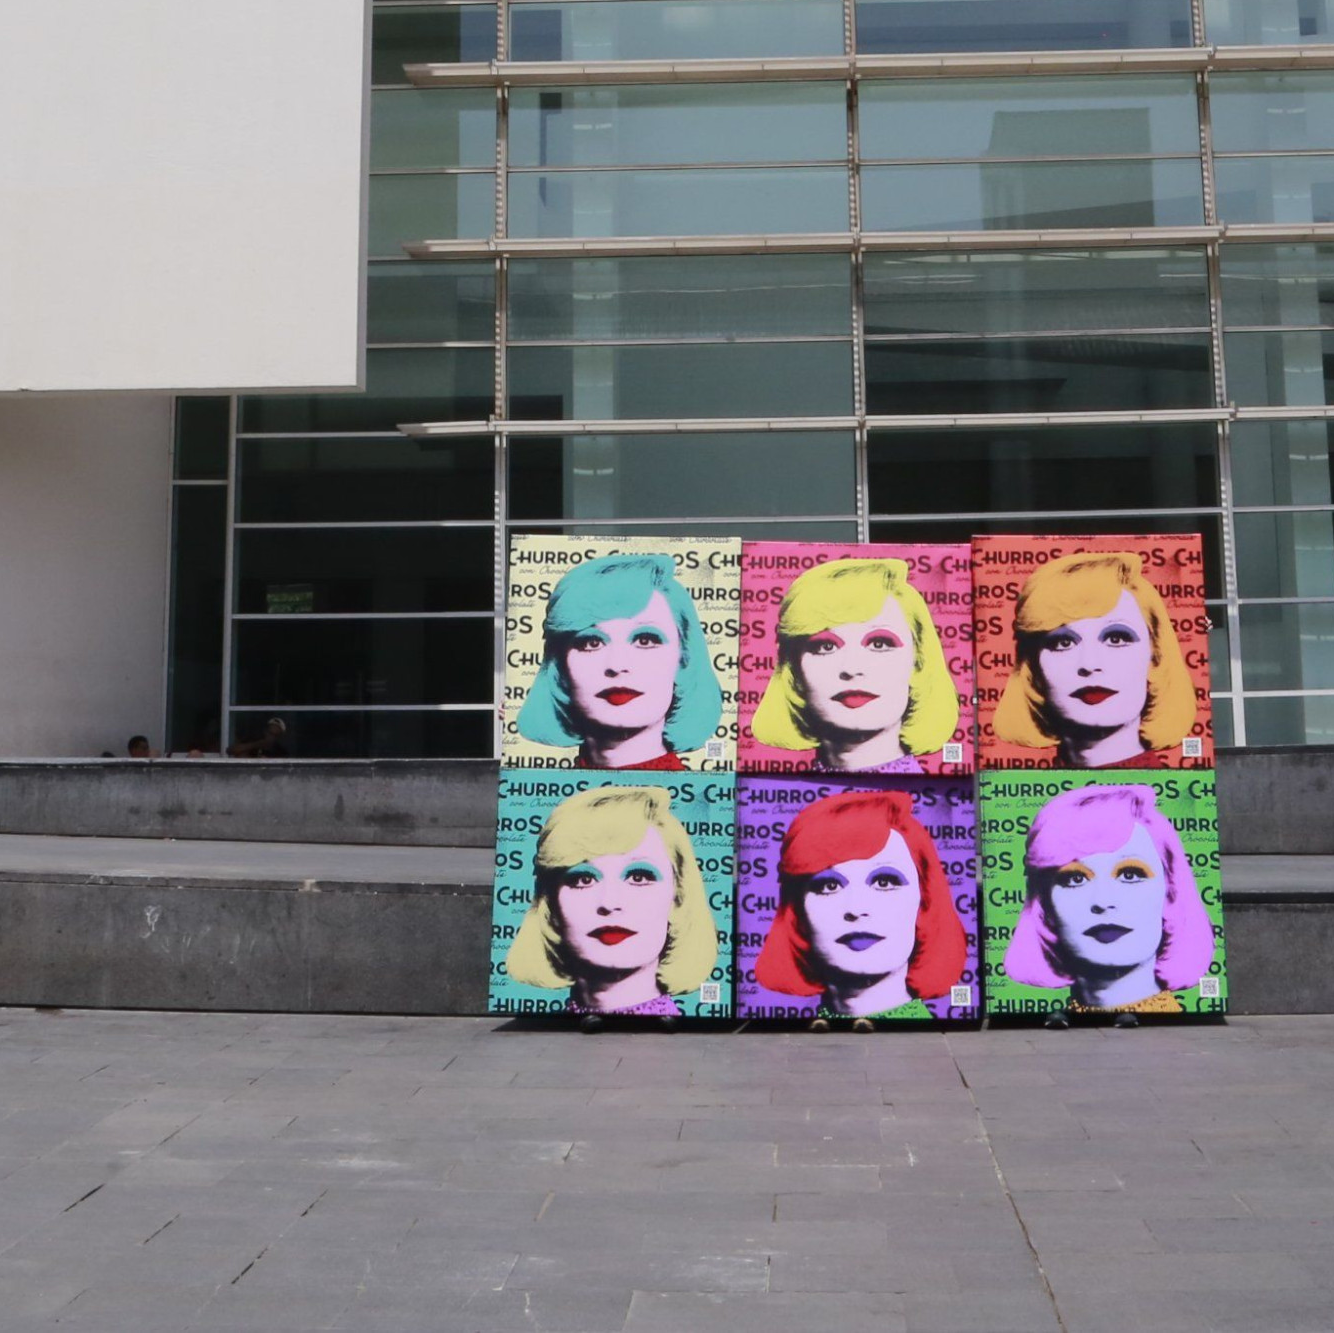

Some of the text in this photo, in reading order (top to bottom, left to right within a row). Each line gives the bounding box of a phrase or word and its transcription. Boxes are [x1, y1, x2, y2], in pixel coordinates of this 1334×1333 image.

[685, 587, 741, 602] URRO
[506, 615, 533, 635] OS
[505, 687, 533, 700] RR
[738, 691, 765, 705] RR
[977, 688, 1005, 702] RR
[498, 779, 589, 798] CHURROS
[495, 850, 524, 870] OS
[983, 852, 1014, 871] OS
[492, 925, 520, 939] RR
[737, 932, 768, 947] RR
